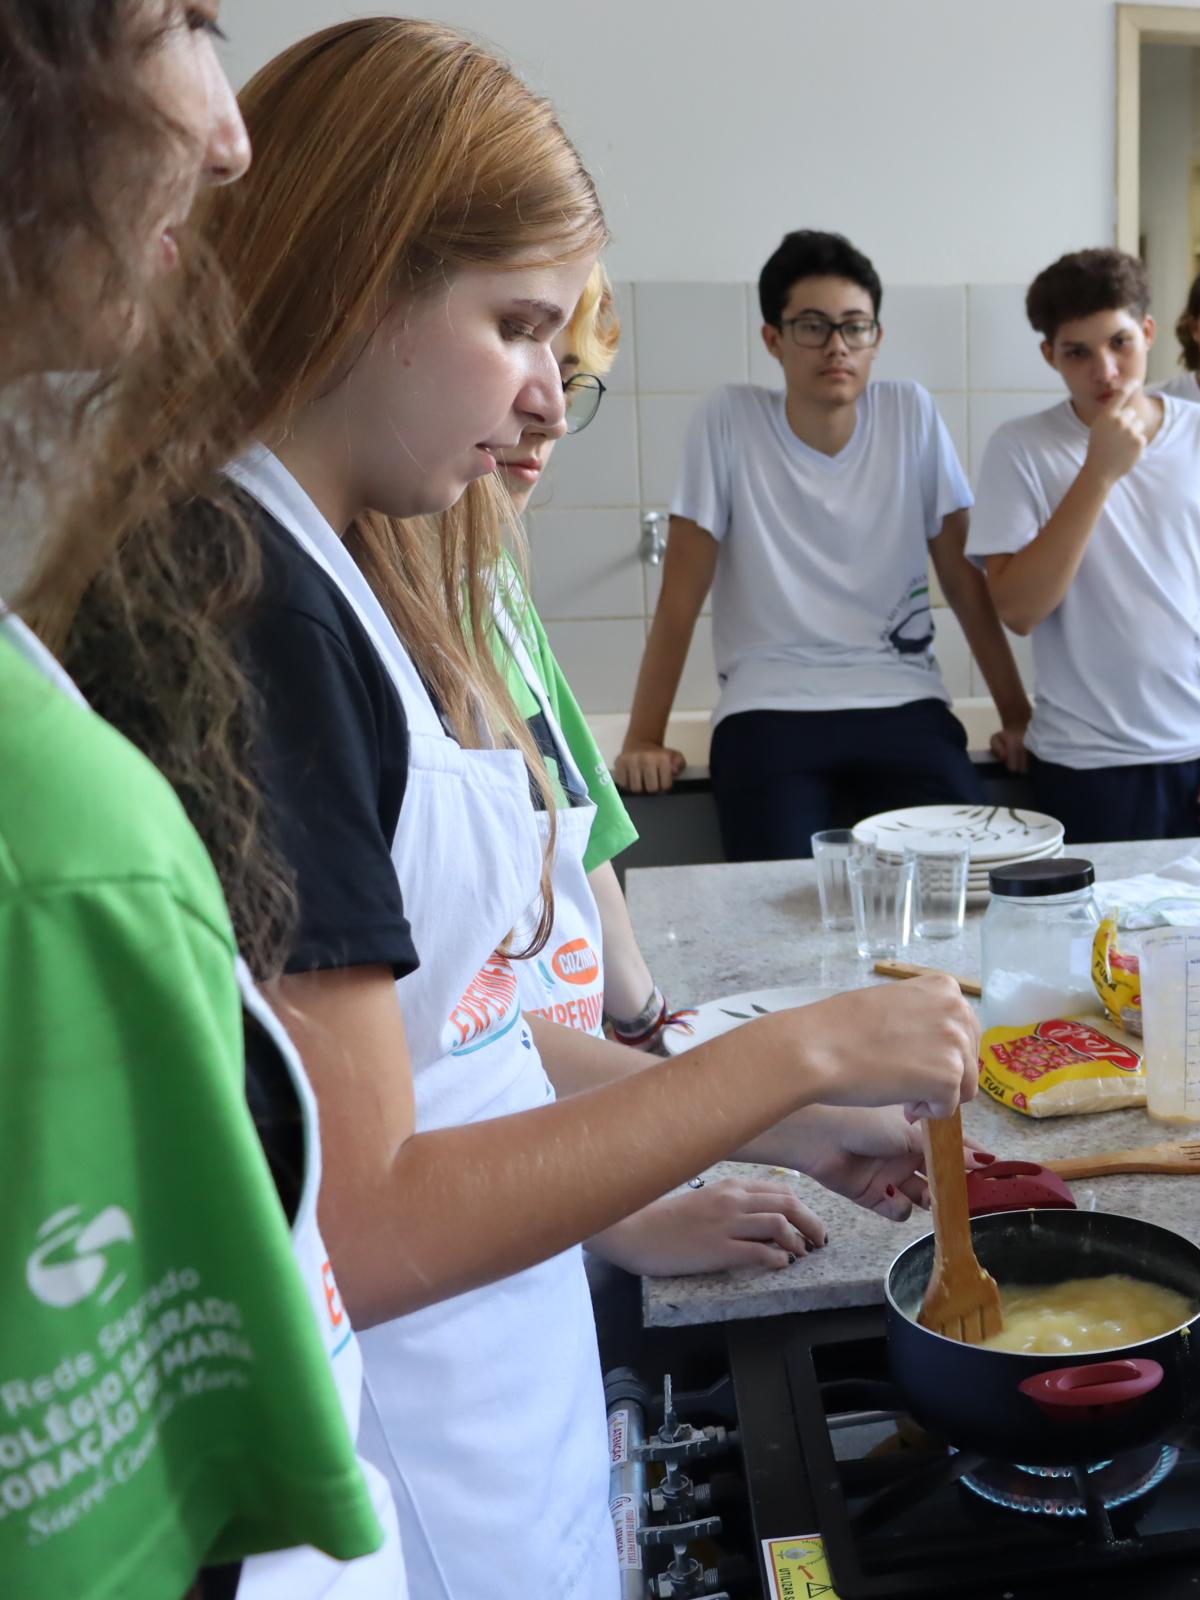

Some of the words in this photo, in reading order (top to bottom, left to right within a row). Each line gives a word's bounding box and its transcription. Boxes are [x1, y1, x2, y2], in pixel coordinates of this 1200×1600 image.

[0, 1372, 123, 1469] OLÉGIO
[1, 1352, 95, 1416] Rede
[0, 1402, 138, 1518] ORAÇÃO
[778, 1567, 794, 1596] UTILIZAR
